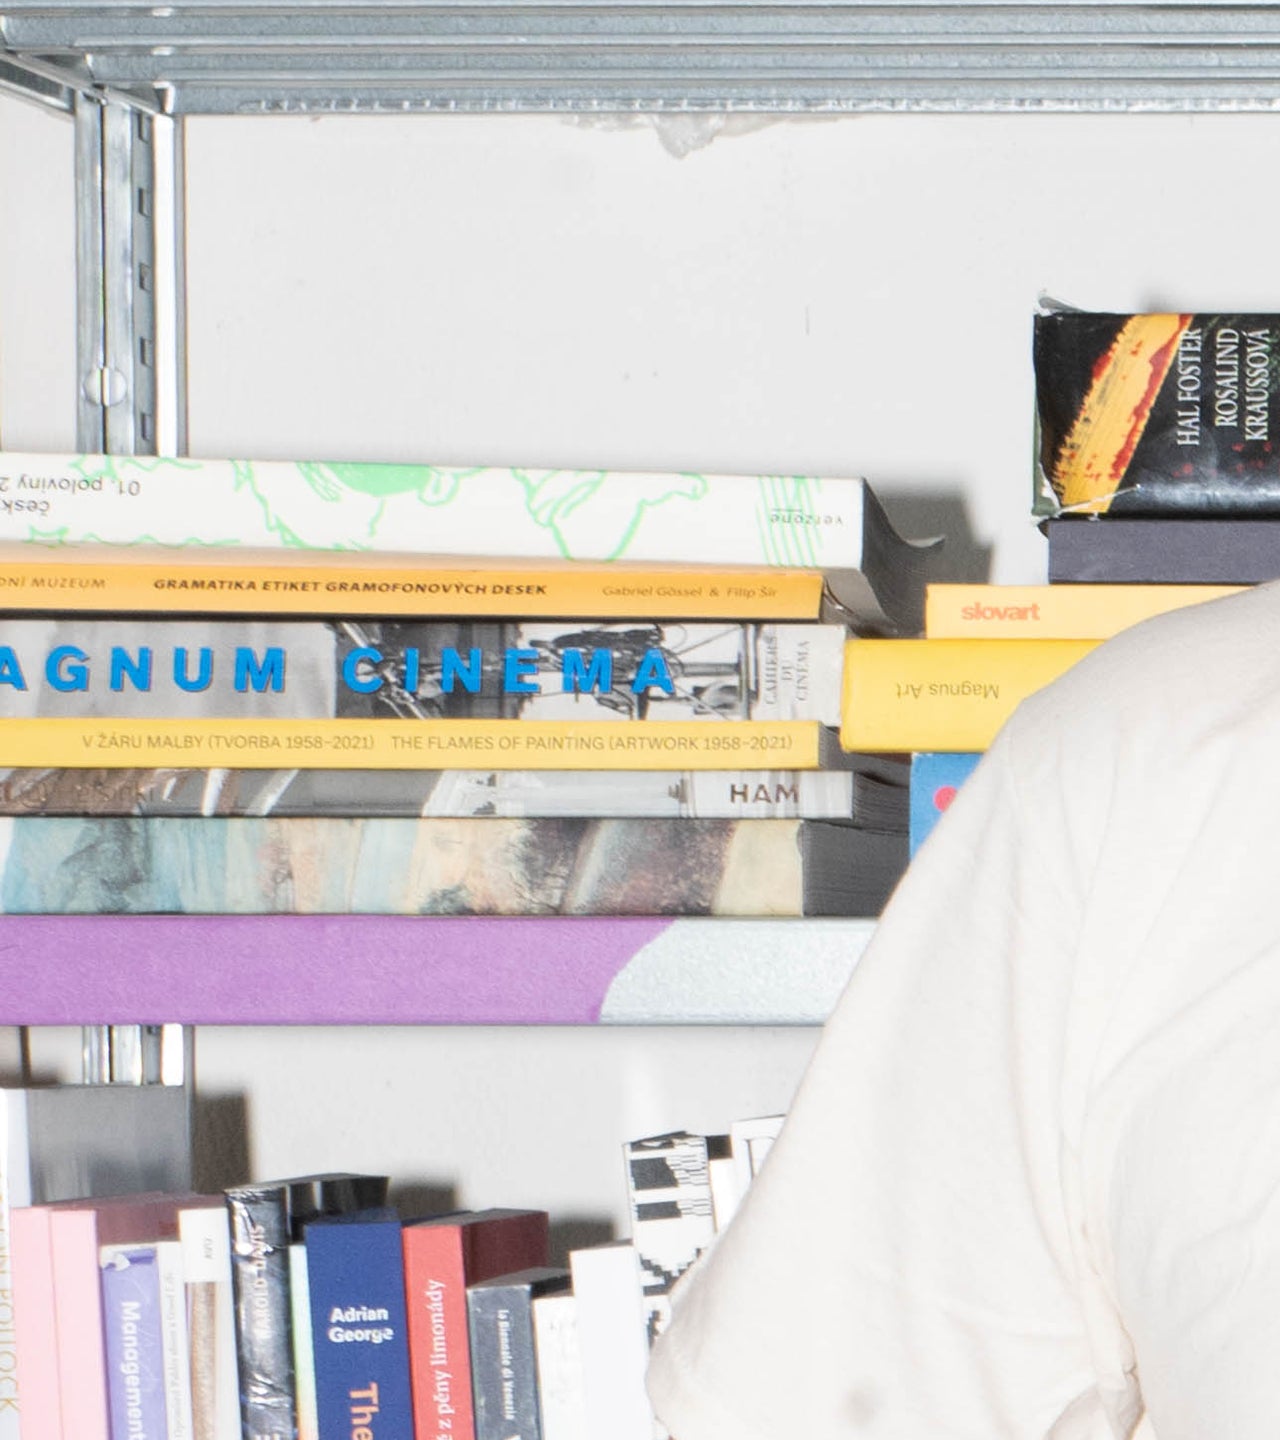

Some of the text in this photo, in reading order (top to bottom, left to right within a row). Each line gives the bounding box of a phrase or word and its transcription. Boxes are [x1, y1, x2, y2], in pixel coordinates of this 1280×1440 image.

[1174, 325, 1202, 446] HAL FOSTER
[1214, 328, 1240, 427] ROSALIND
[1244, 328, 1273, 441] KRAUSSOVÁ
[153, 579, 549, 597] GRAMATIKA ETIKET GRAMOFONOVÝCH DESEK
[961, 601, 1041, 621] slovart
[343, 643, 680, 700] CINEMA
[896, 679, 1000, 700] Magnus Art
[390, 734, 701, 752] THE FLAMES OF PAINTING (ARTWORK
[730, 779, 800, 805] HAM
[329, 1305, 389, 1324] Adrian
[327, 1326, 394, 1344] George
